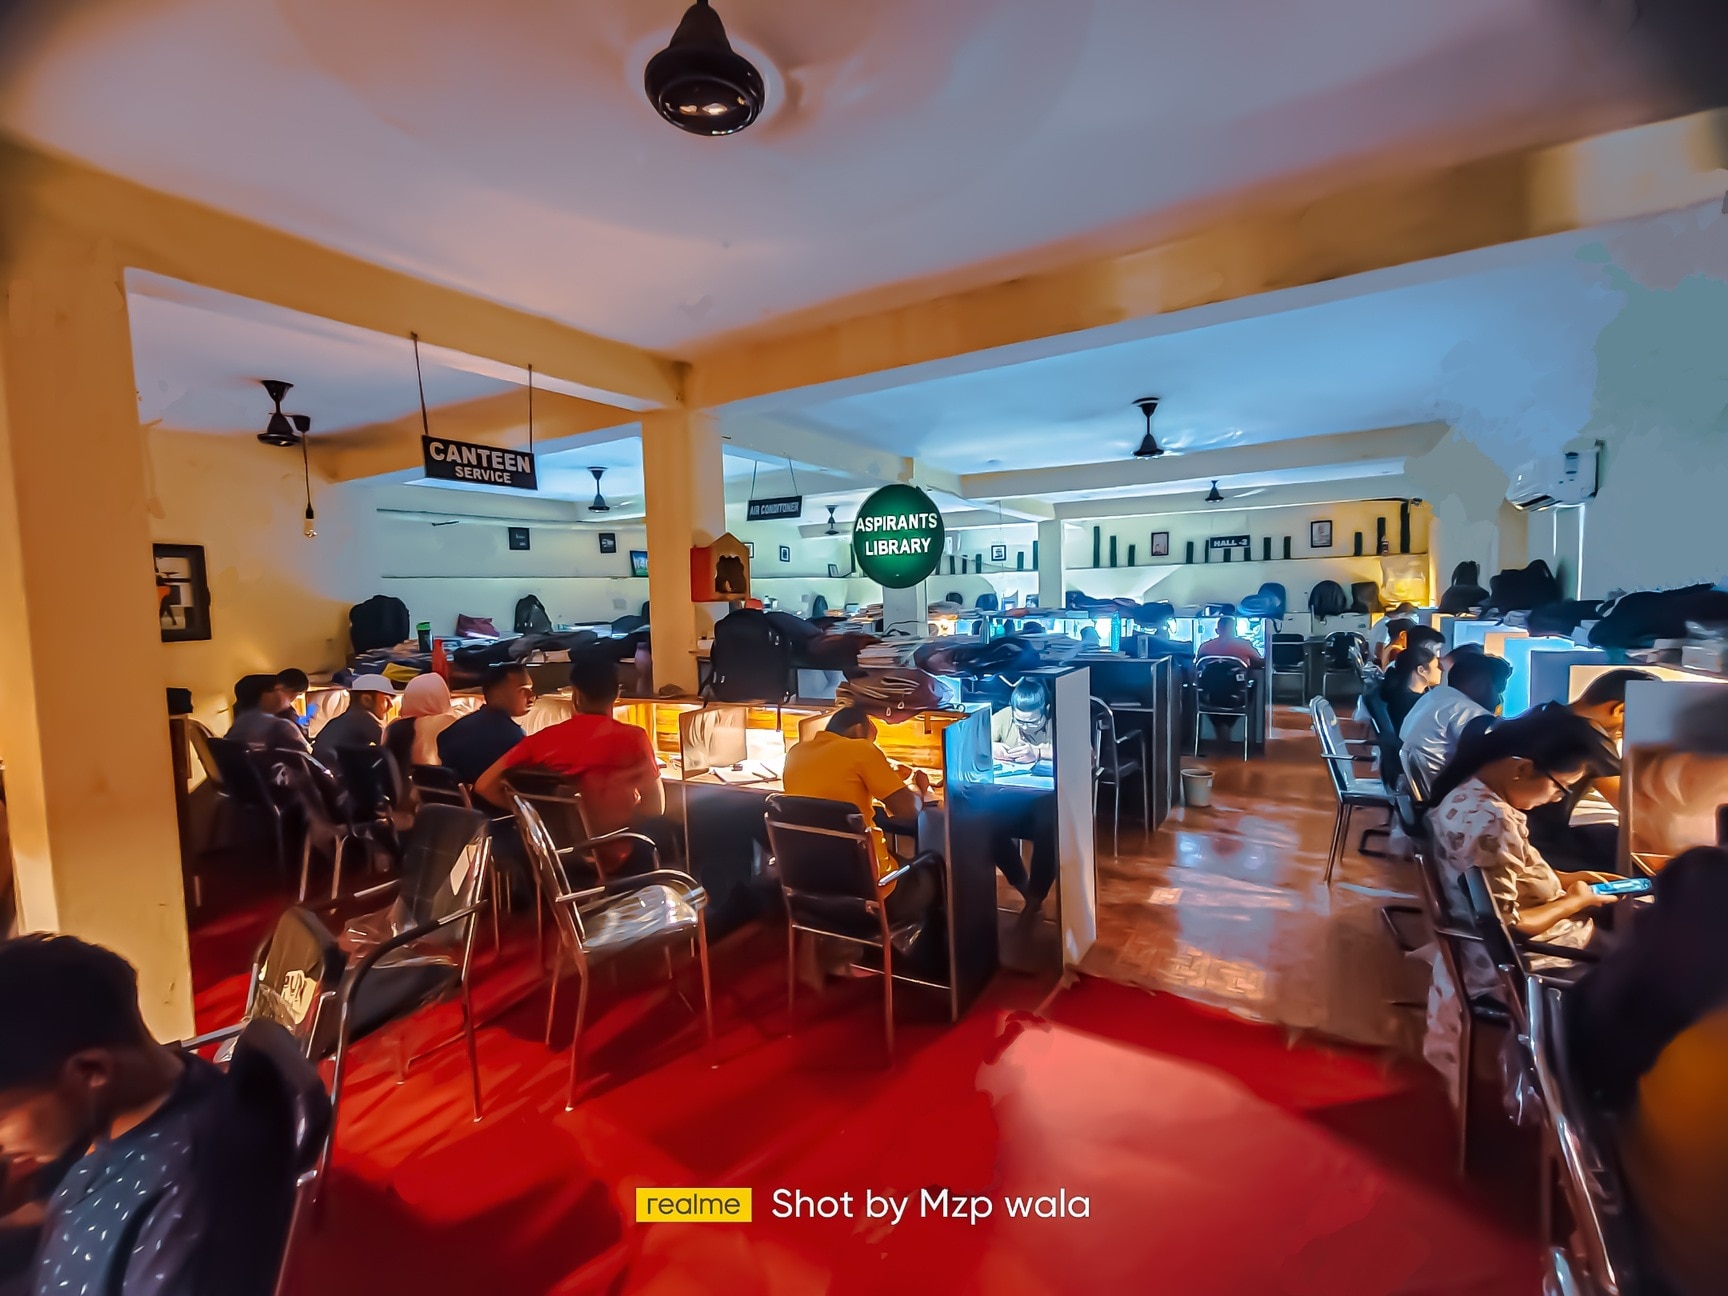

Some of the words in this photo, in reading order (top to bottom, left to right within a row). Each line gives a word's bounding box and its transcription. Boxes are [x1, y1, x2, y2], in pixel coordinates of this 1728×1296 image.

[429, 441, 531, 474] CANTEEN
[454, 465, 512, 484] SERVICE
[855, 513, 938, 532] ASPIRANTS
[865, 538, 932, 556] LIBRARY
